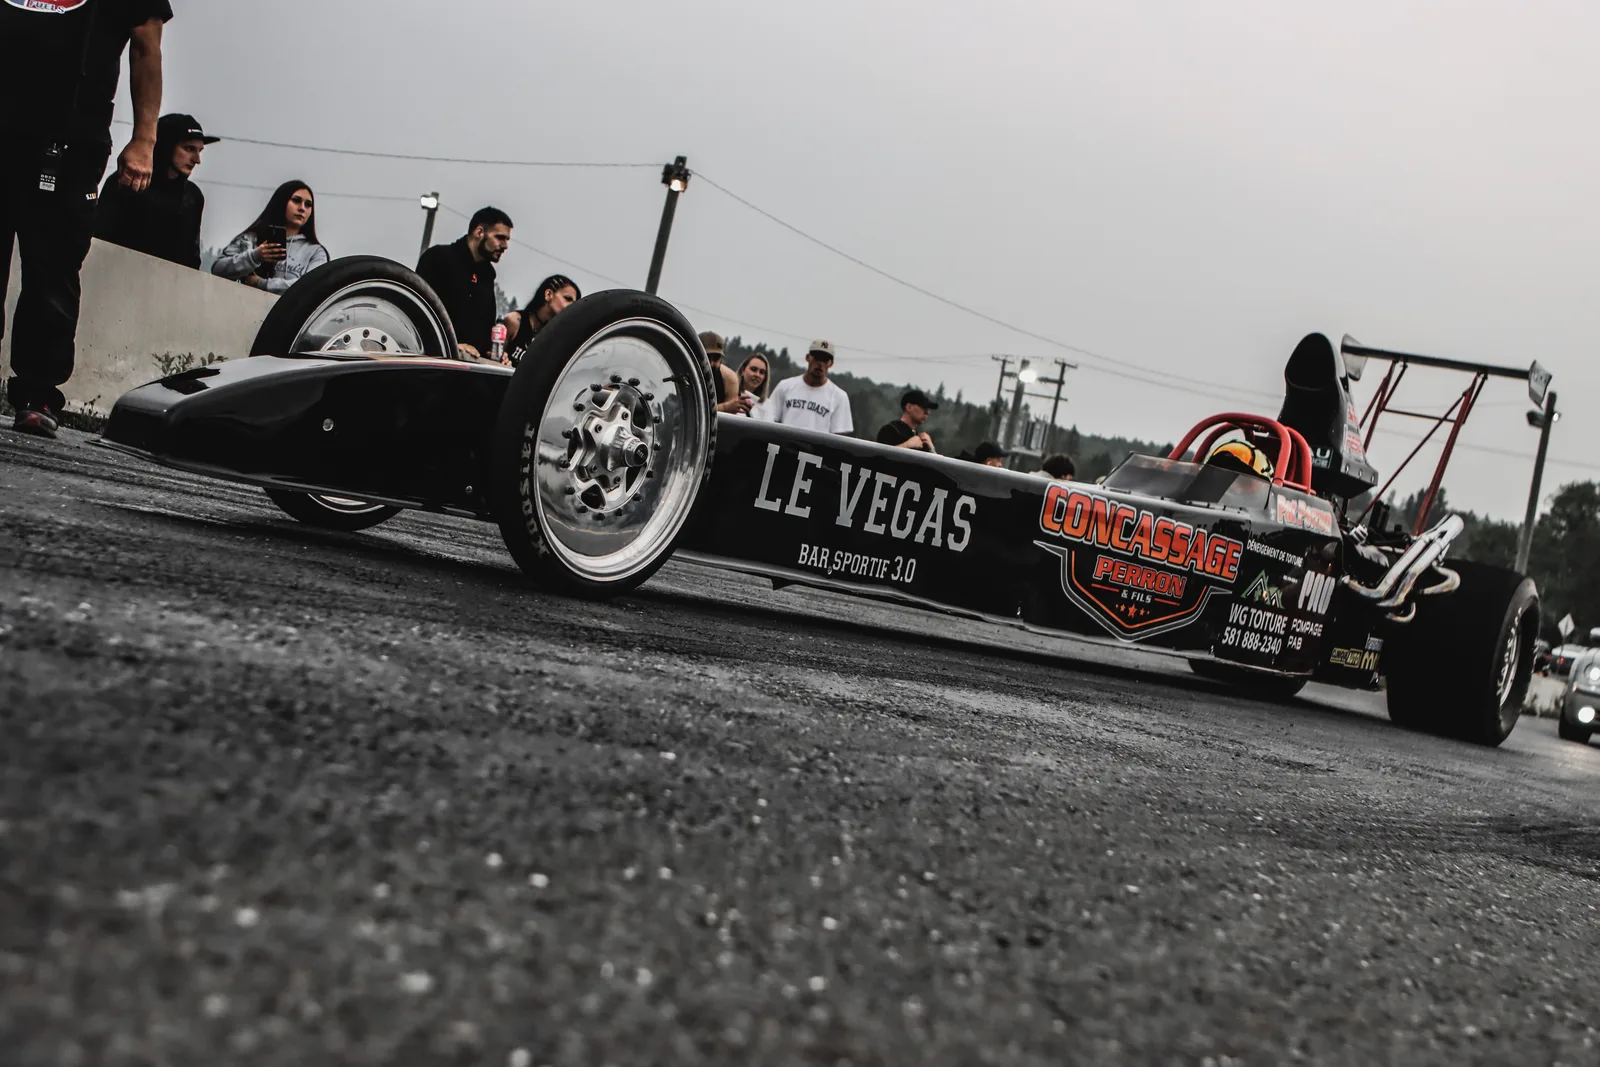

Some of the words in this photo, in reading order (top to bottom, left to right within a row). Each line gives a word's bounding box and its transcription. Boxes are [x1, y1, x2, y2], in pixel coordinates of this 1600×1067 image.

[785, 399, 807, 409] WEST
[807, 401, 830, 417] COAST
[753, 442, 823, 519] LE
[835, 462, 978, 552] VEGAS
[1040, 481, 1243, 584] CONCASSAGE
[798, 543, 830, 569] BAR
[832, 550, 890, 579] SPORTIF
[891, 556, 917, 583] 3.0
[1246, 538, 1280, 560] DÉNEIGEMENT
[1278, 549, 1286, 562] DE
[1285, 553, 1304, 567] TOITURE
[1093, 555, 1188, 599] PERRON
[1120, 589, 1129, 599] &
[1130, 590, 1153, 604] FILS
[1228, 602, 1249, 626] WG
[1248, 607, 1288, 635] TOITURE
[1291, 617, 1324, 637] POMPAGE
[1221, 626, 1241, 647] 581
[1241, 630, 1282, 655] 888-2340
